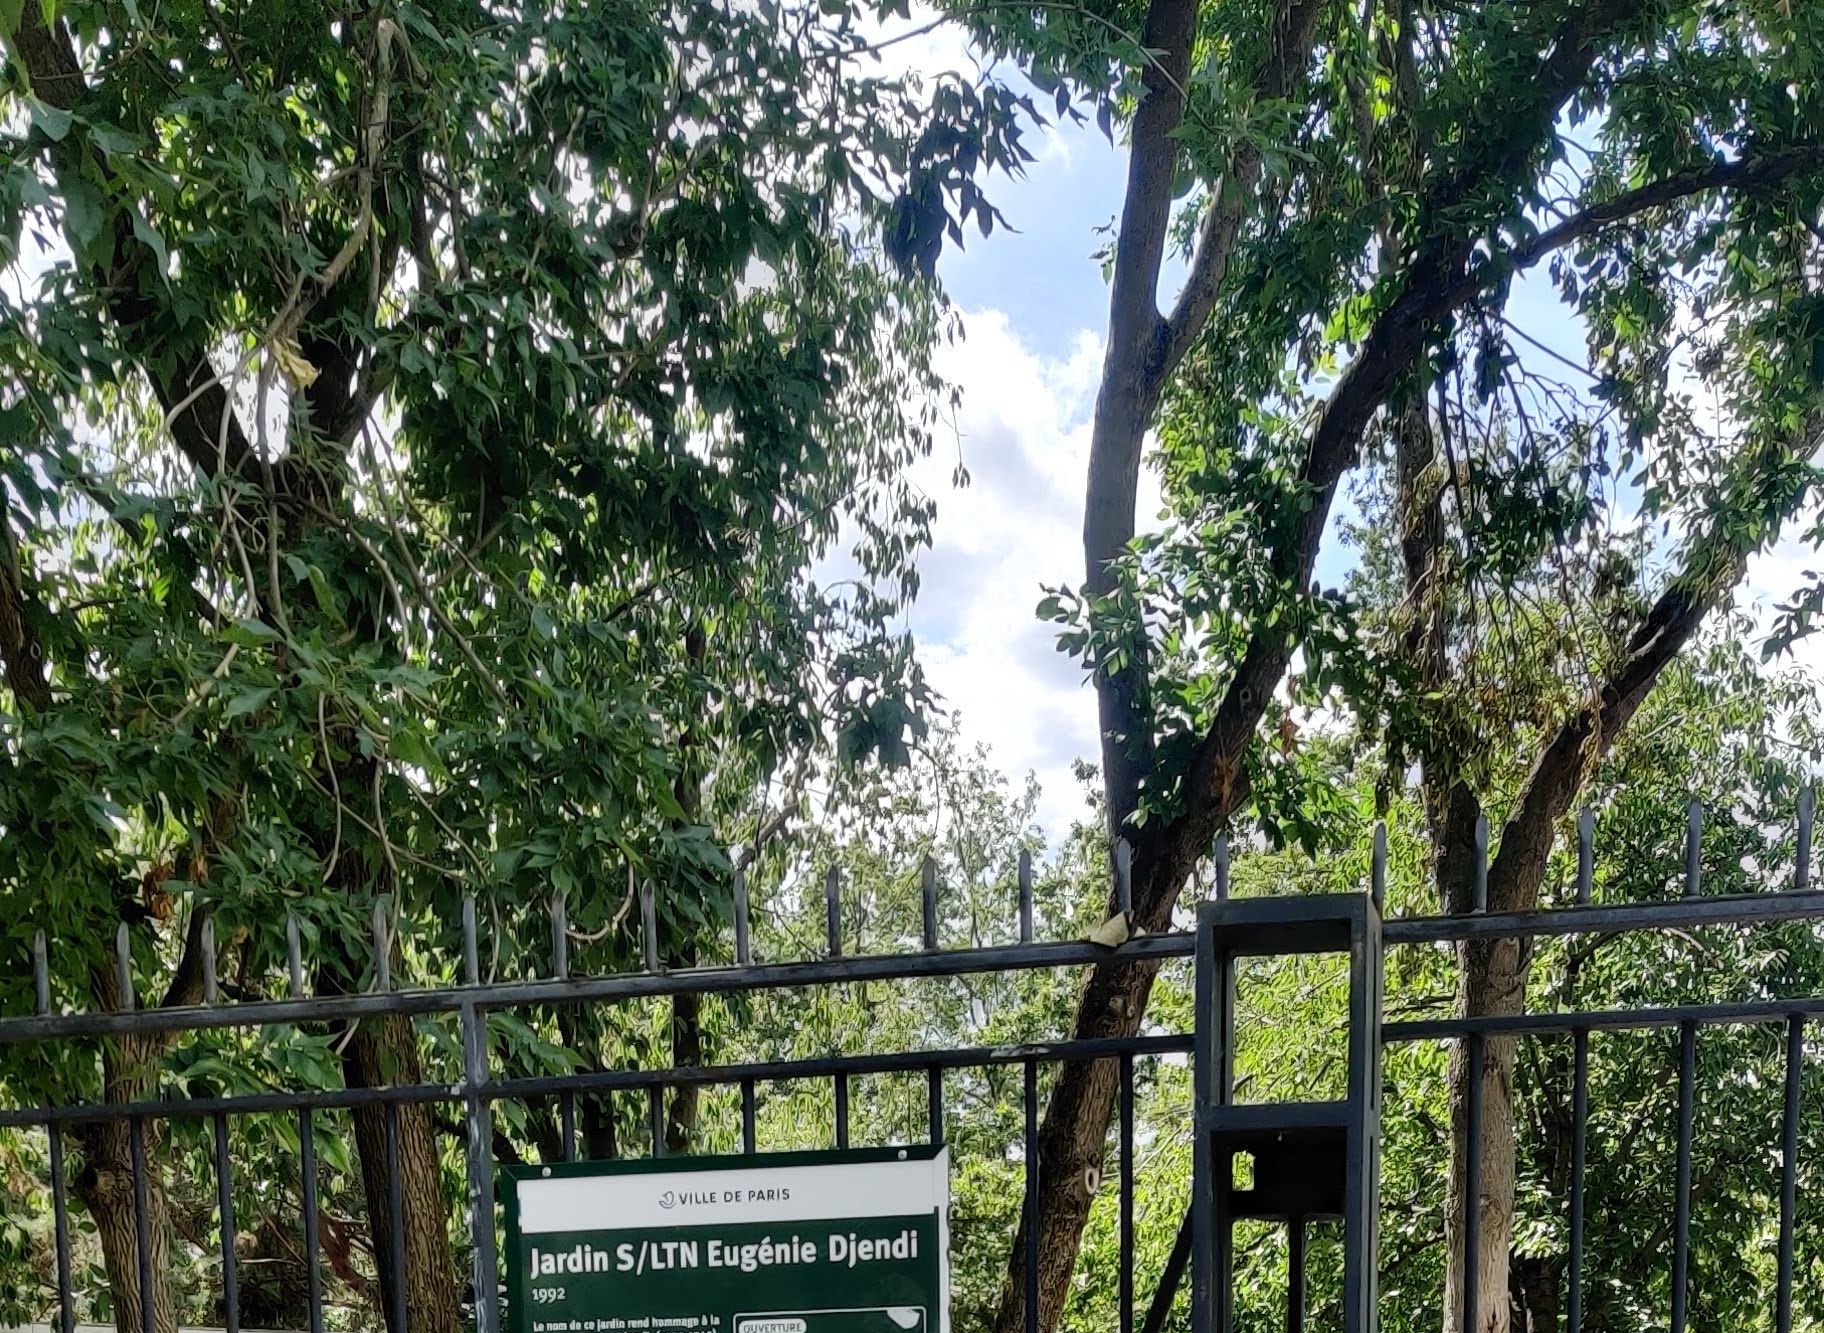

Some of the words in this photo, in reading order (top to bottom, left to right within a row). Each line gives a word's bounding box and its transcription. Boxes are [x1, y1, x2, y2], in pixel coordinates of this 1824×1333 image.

[679, 1191, 717, 1205] VILLE
[723, 1190, 742, 1202] DE
[748, 1188, 790, 1202] PARIS
[530, 1245, 608, 1279] Jardin
[616, 1241, 698, 1276] S/LTN
[708, 1236, 816, 1272] Eugénie
[829, 1230, 918, 1268] Djendi
[532, 1287, 565, 1304] 1992
[743, 1323, 801, 1333] OUVERTURE
